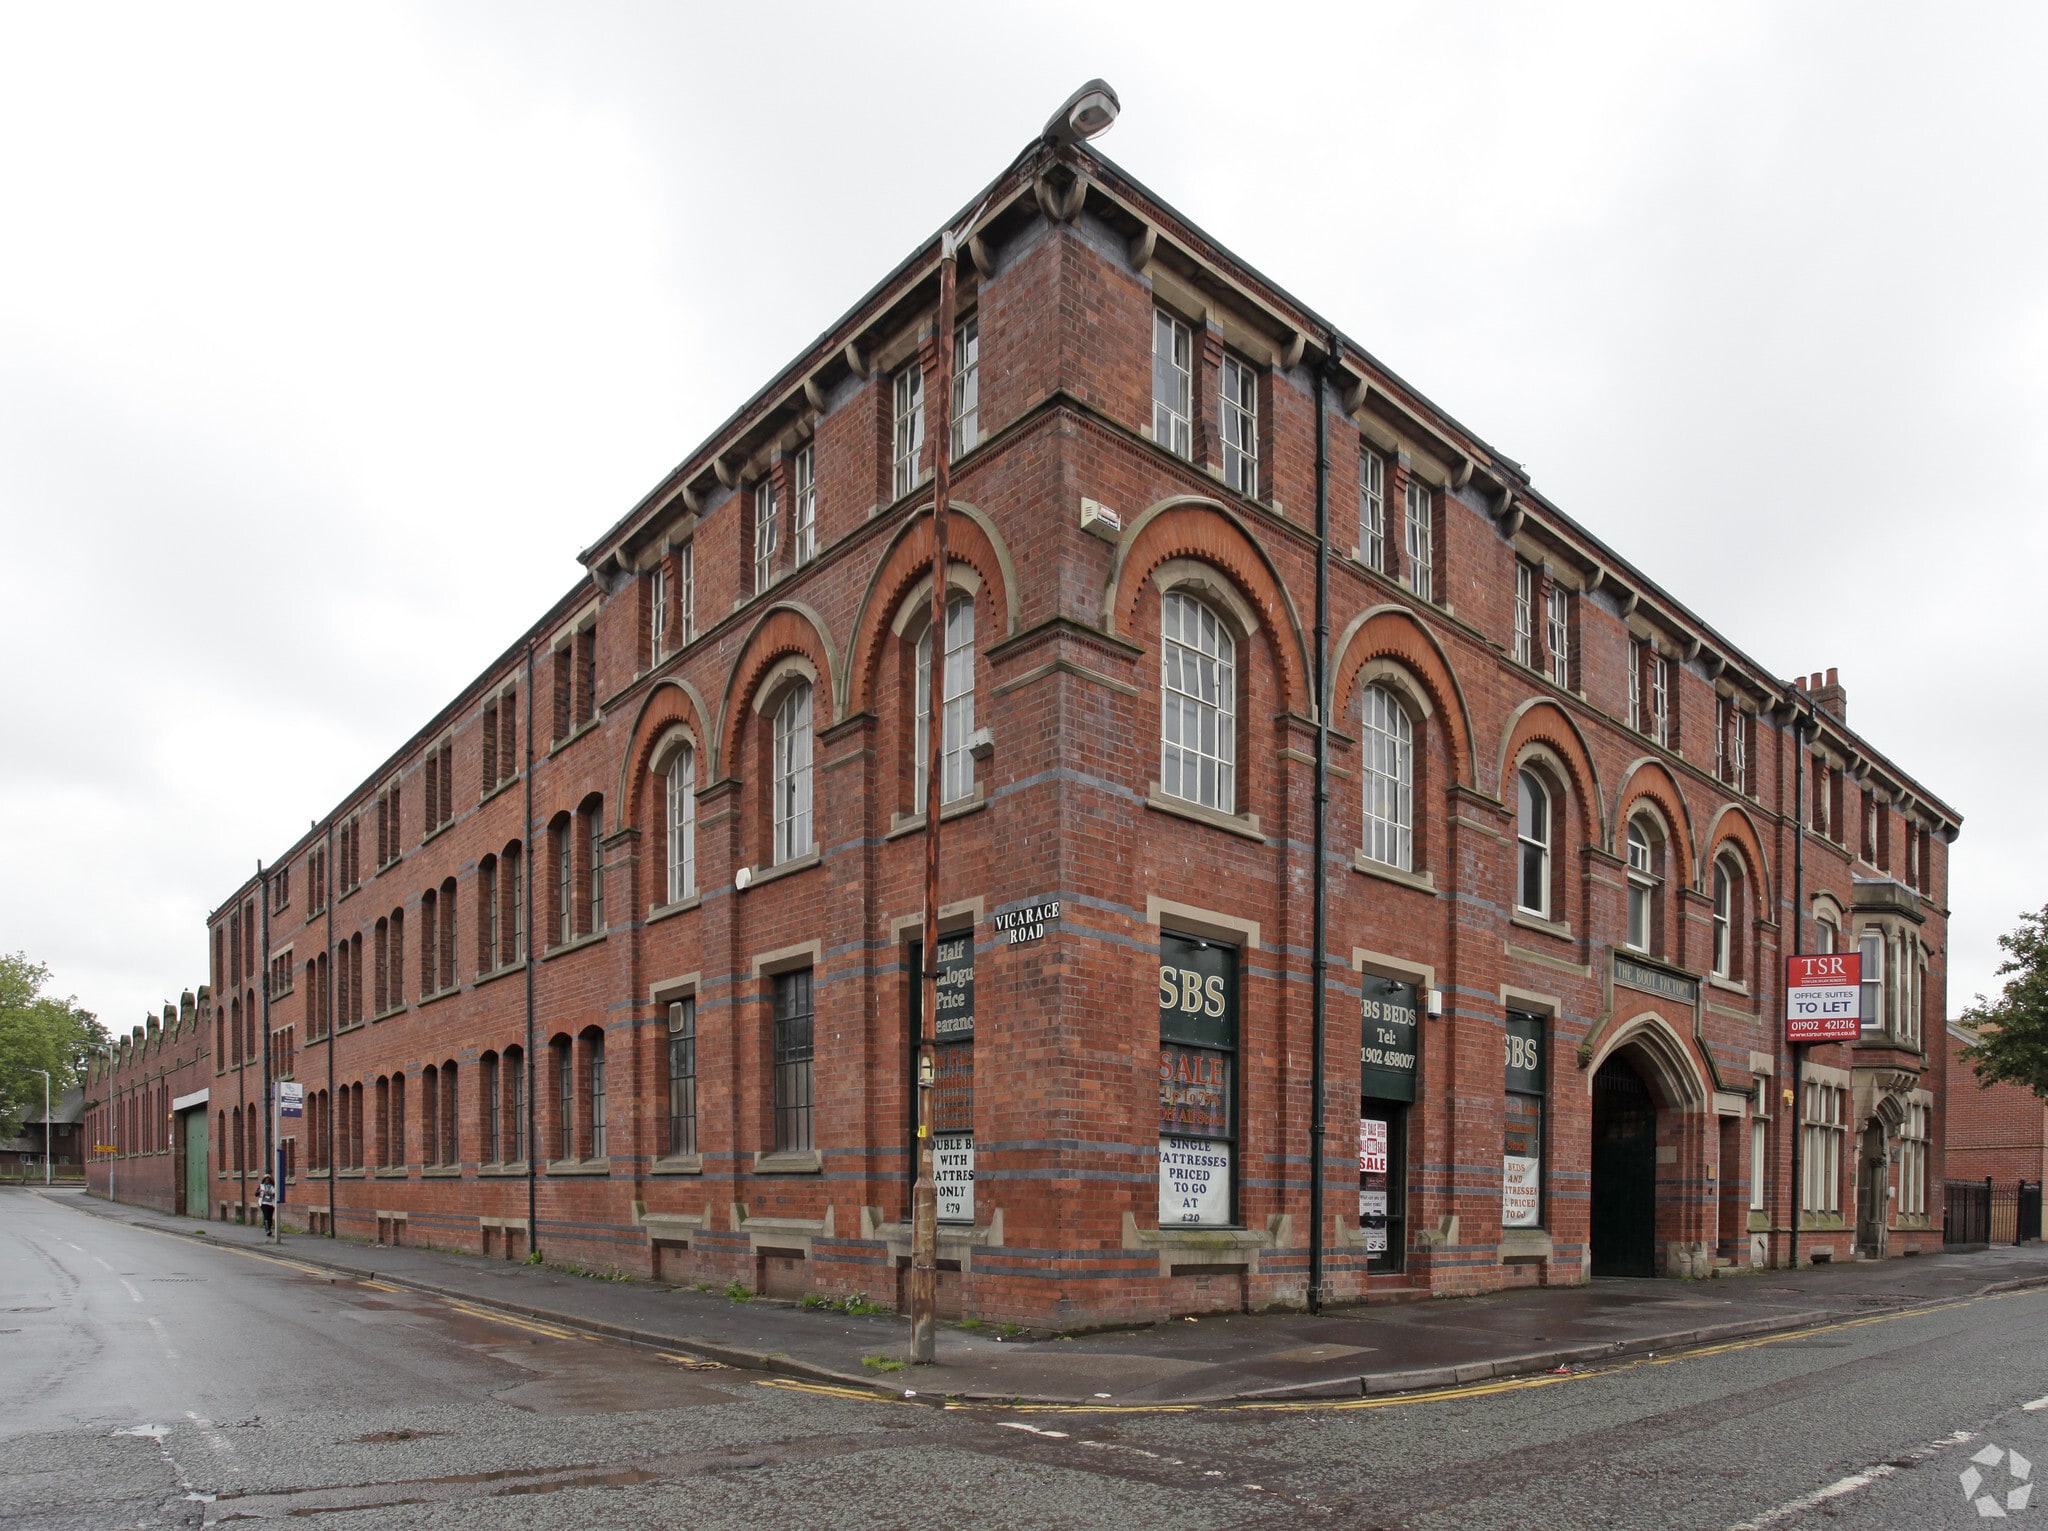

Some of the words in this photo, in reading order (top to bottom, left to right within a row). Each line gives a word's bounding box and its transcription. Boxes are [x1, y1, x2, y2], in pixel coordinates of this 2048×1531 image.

[995, 901, 1060, 931] VICARAGE
[1010, 923, 1044, 944] ROAD
[937, 941, 964, 963] Half
[1801, 957, 1847, 976] TSR
[937, 966, 974, 988] alogu
[1616, 961, 1633, 981] THE
[1636, 967, 1656, 987] BOOT
[1159, 965, 1226, 1018] SBS
[1825, 990, 1853, 998] SUITES
[936, 990, 965, 1010] Price
[1796, 1002, 1817, 1013] TO
[1823, 1001, 1851, 1012] LET
[1361, 999, 1380, 1019] BS
[1383, 1003, 1416, 1026] BEDS
[936, 1015, 974, 1034] earanc
[1791, 1021, 1819, 1030] 01902
[1825, 1020, 1855, 1029] 421216
[1377, 1027, 1396, 1045] Tel:
[1360, 1047, 1383, 1064] 1902
[1384, 1050, 1415, 1069] 458007
[1160, 1051, 1224, 1086] SALE
[933, 1139, 962, 1151] UBLE
[1169, 1138, 1211, 1152] SINGLE
[940, 1154, 967, 1166] WITH
[1159, 1152, 1227, 1168] ATTRESSES
[1360, 1156, 1386, 1171] SALE
[1507, 1162, 1526, 1172] BEDS
[935, 1170, 974, 1181] ATTRES
[1169, 1167, 1210, 1181] PRICED
[1508, 1174, 1523, 1184] AND
[939, 1186, 966, 1197] ONLY
[1174, 1181, 1189, 1193] TO
[1191, 1183, 1207, 1194] GO
[945, 1202, 960, 1214] £79
[1182, 1197, 1198, 1208] AT
[1511, 1199, 1536, 1208] PRICED
[1182, 1213, 1200, 1222] £20
[1506, 1209, 1515, 1219] TO
